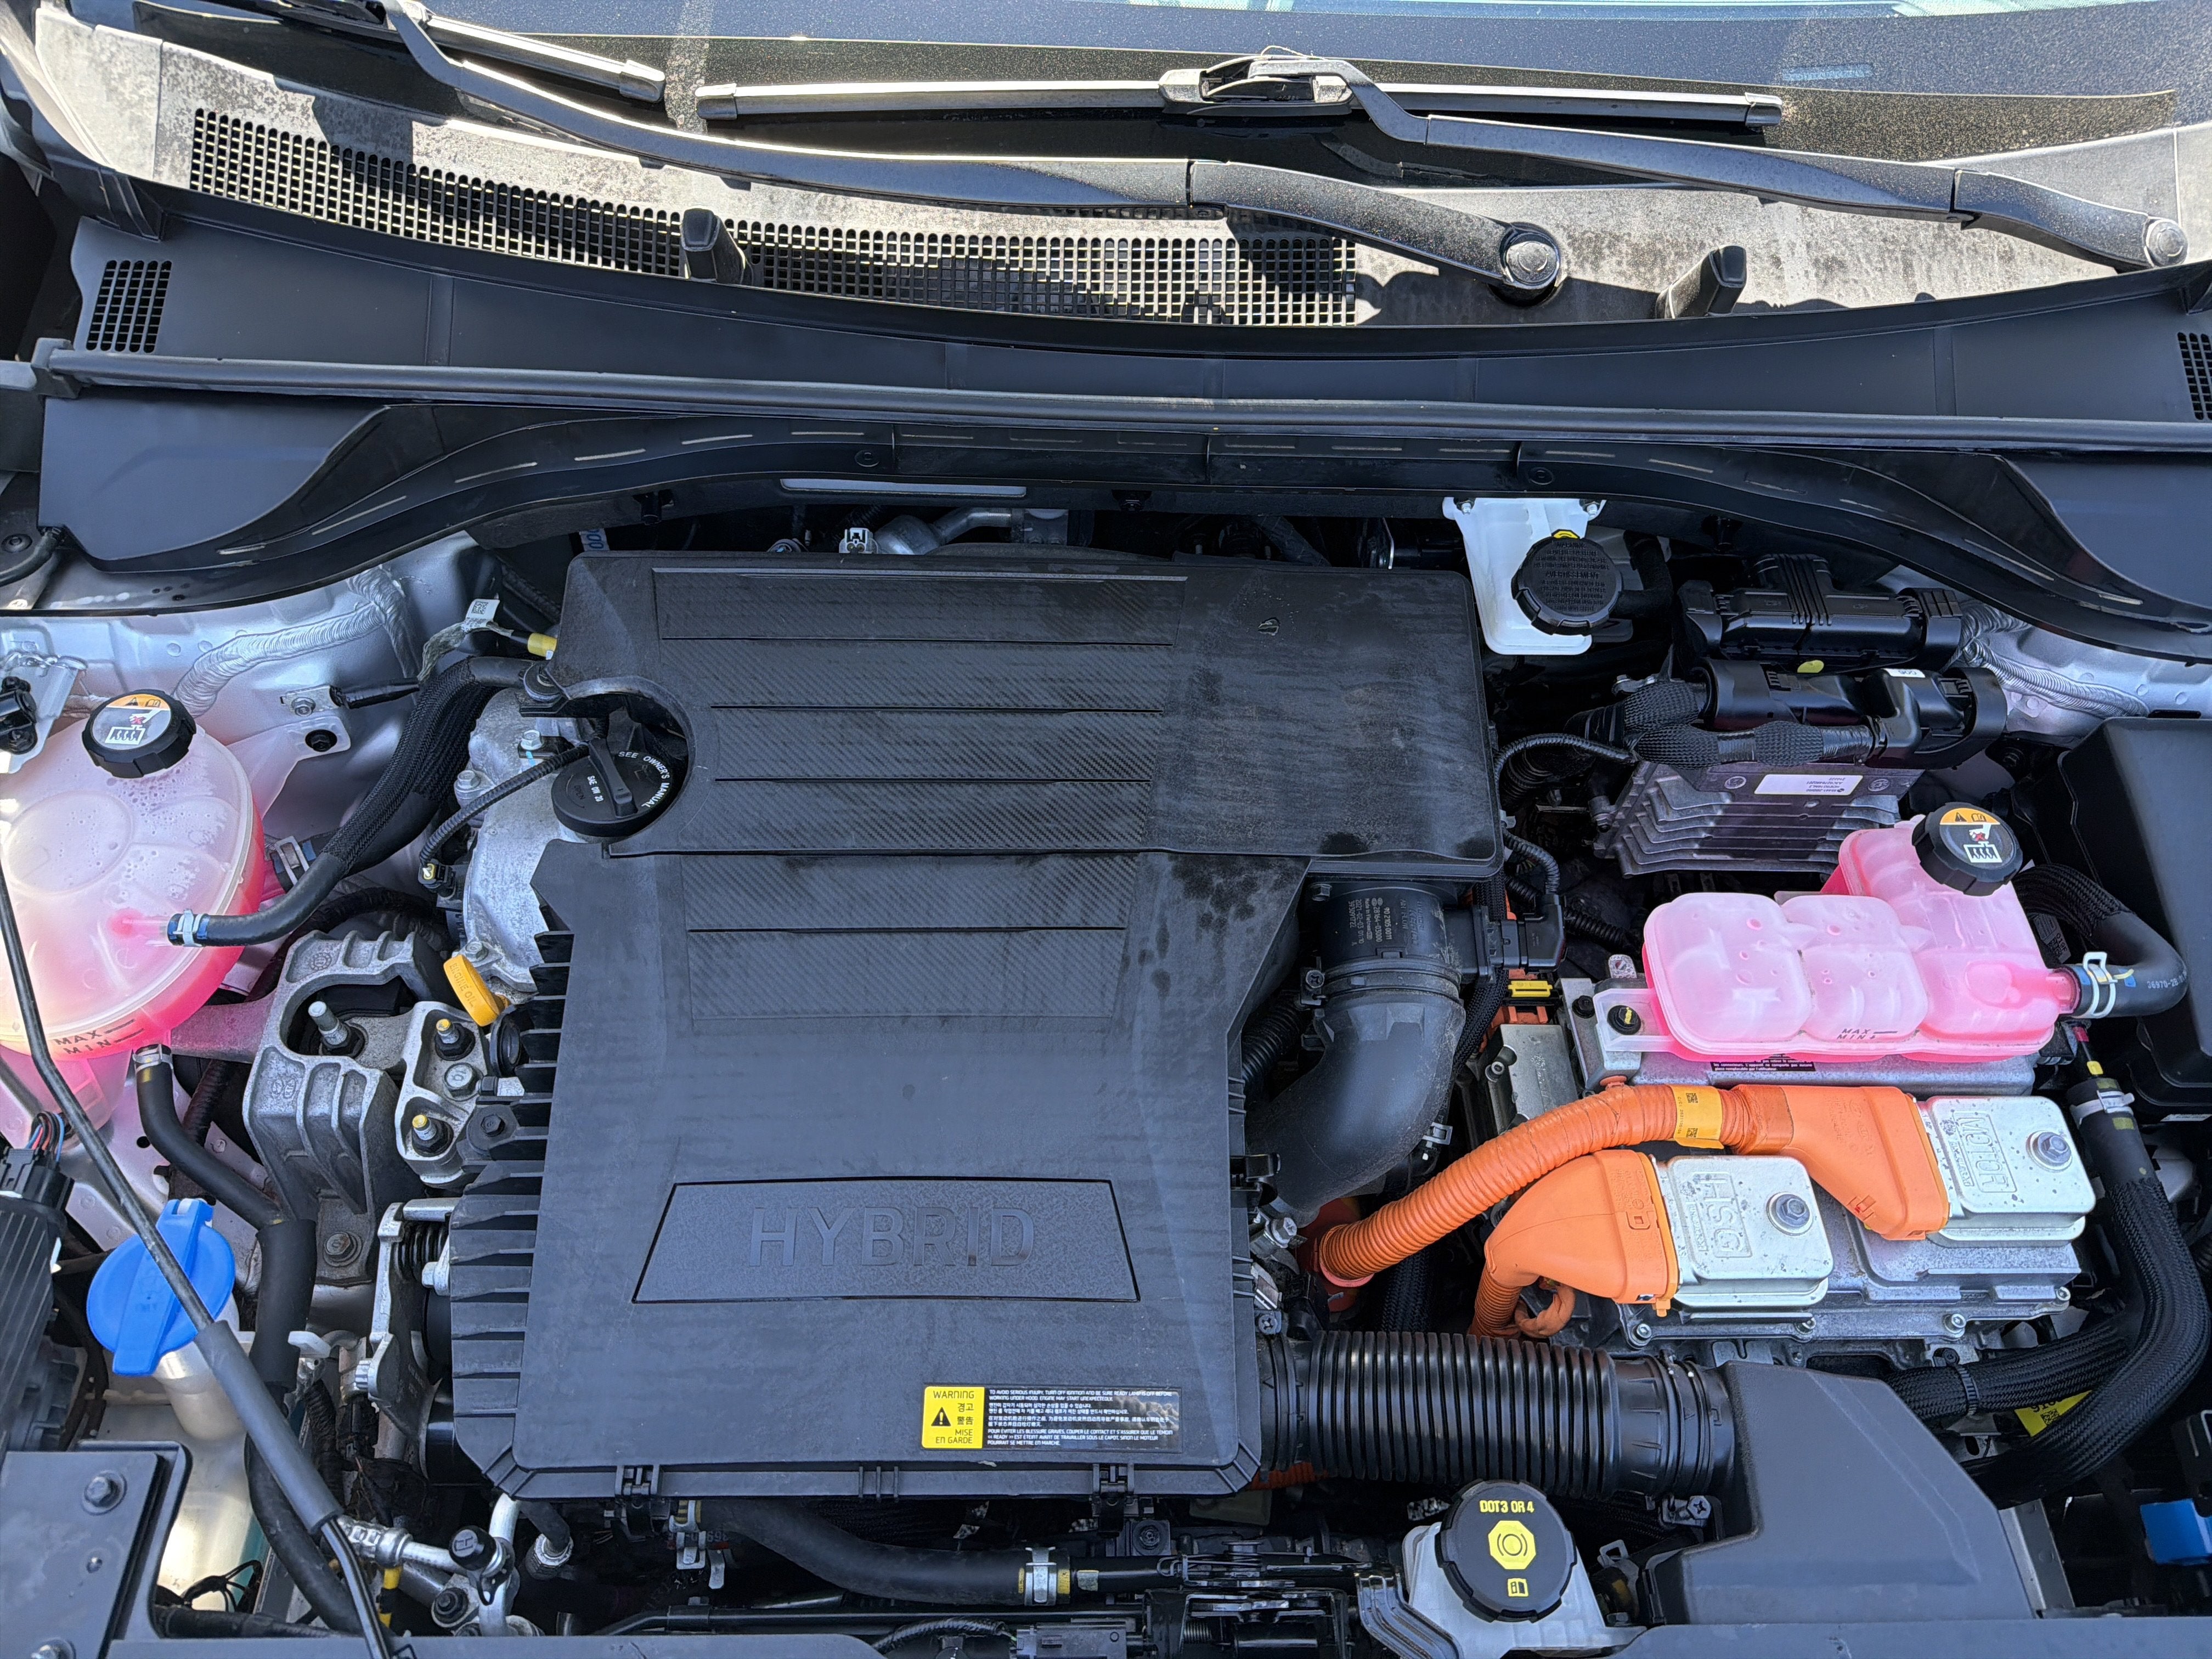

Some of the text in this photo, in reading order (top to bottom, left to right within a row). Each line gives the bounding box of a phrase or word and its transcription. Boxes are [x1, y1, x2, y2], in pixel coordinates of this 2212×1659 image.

[643, 756, 670, 779] OWNER'S
[587, 775, 597, 786] SAE
[574, 785, 585, 800] OPEN
[641, 782, 670, 808] MANUAL
[449, 963, 476, 1007] ENGINE OIL
[54, 1030, 103, 1045] MAX
[63, 1039, 113, 1054] MIN
[1955, 1117, 2010, 1188] MOTOR
[1700, 1177, 1743, 1252] HSG
[749, 1206, 1036, 1267] HYBRID
[933, 1390, 974, 1398] WARNING
[957, 1403, 974, 1412] 경고
[1480, 1500, 1534, 1513] DOT3 OR 4
